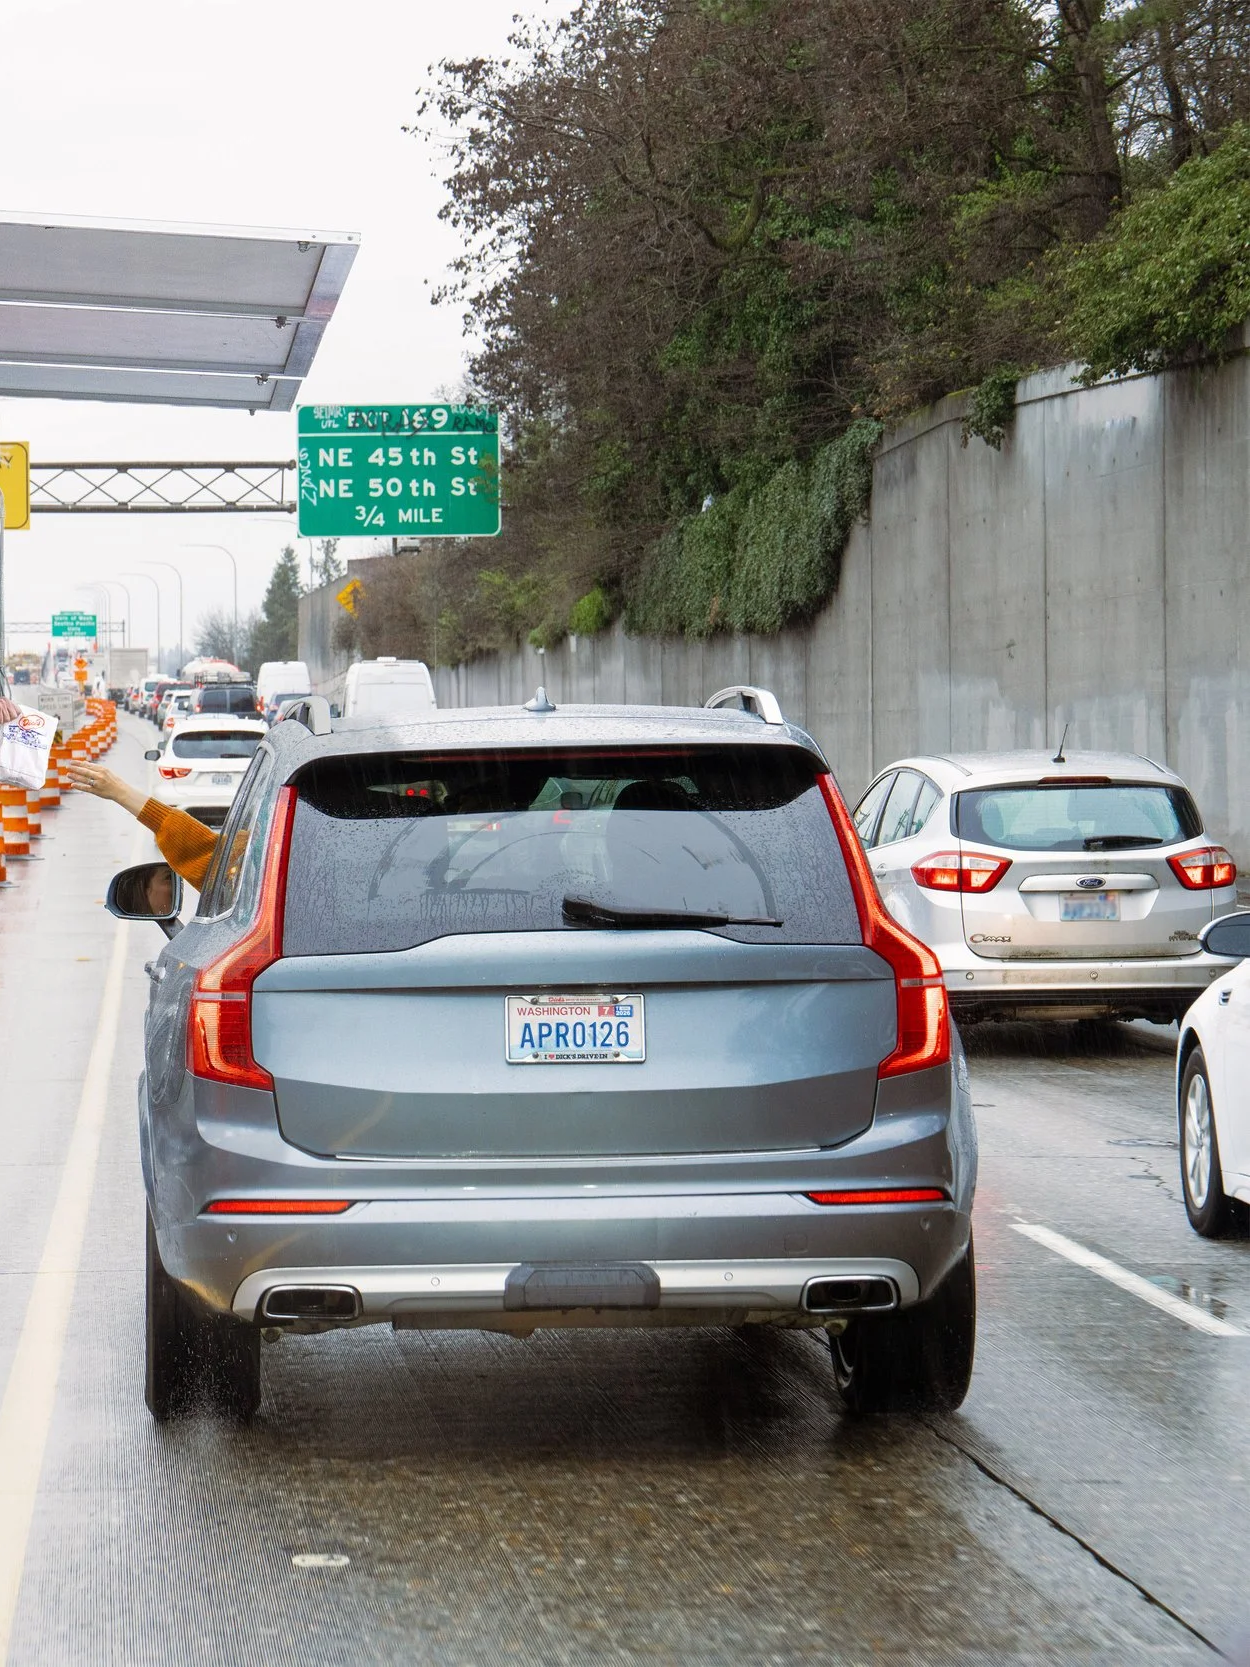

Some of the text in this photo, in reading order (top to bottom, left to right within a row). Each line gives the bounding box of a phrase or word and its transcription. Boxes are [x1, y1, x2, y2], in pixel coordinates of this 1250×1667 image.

[402, 407, 448, 429] 169
[318, 446, 478, 467] NE 45th St
[319, 476, 478, 498] NE 50th St
[398, 507, 444, 523] MILE
[517, 1006, 611, 1016] WASHINGTON 7
[520, 1021, 630, 1049] APR0126
